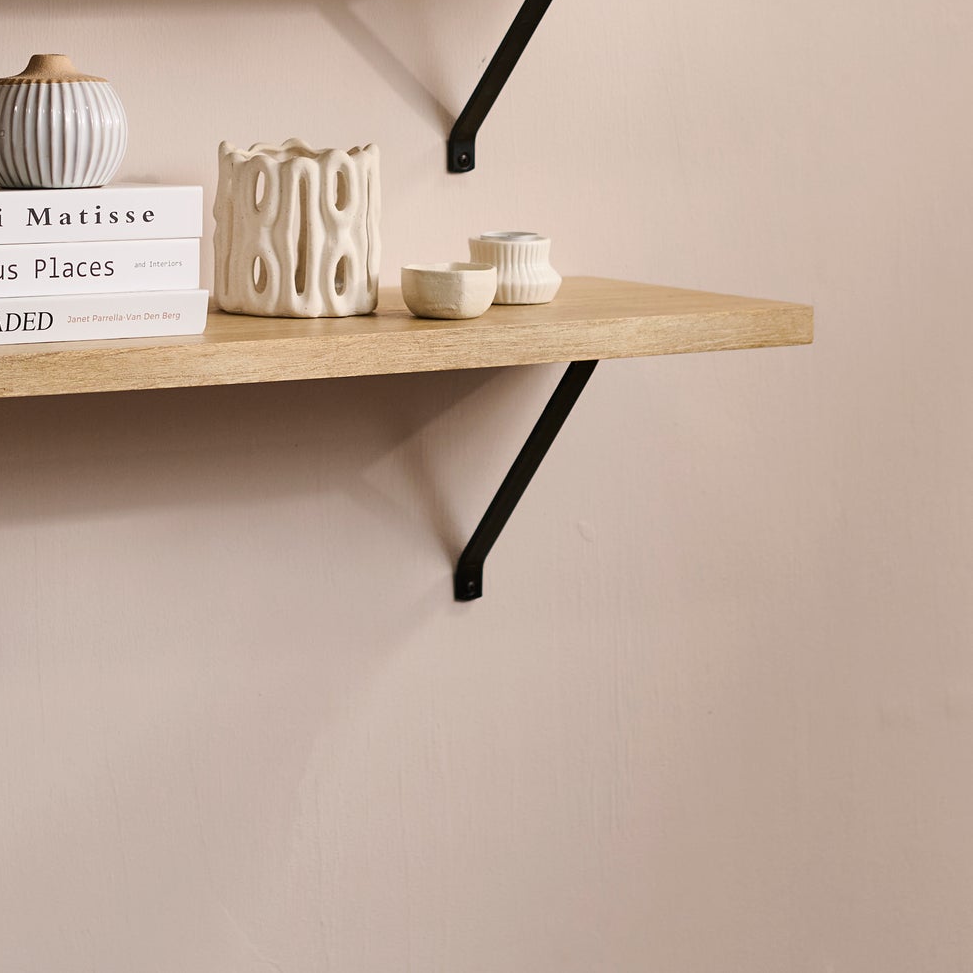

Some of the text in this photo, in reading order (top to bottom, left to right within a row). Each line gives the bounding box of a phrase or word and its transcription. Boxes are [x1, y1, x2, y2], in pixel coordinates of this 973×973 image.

[25, 204, 155, 227] Matisse
[34, 256, 115, 280] Places
[134, 258, 183, 269] and Interiors
[67, 314, 90, 324] Janet
[143, 311, 160, 322] Den
[162, 310, 181, 322] Berg
